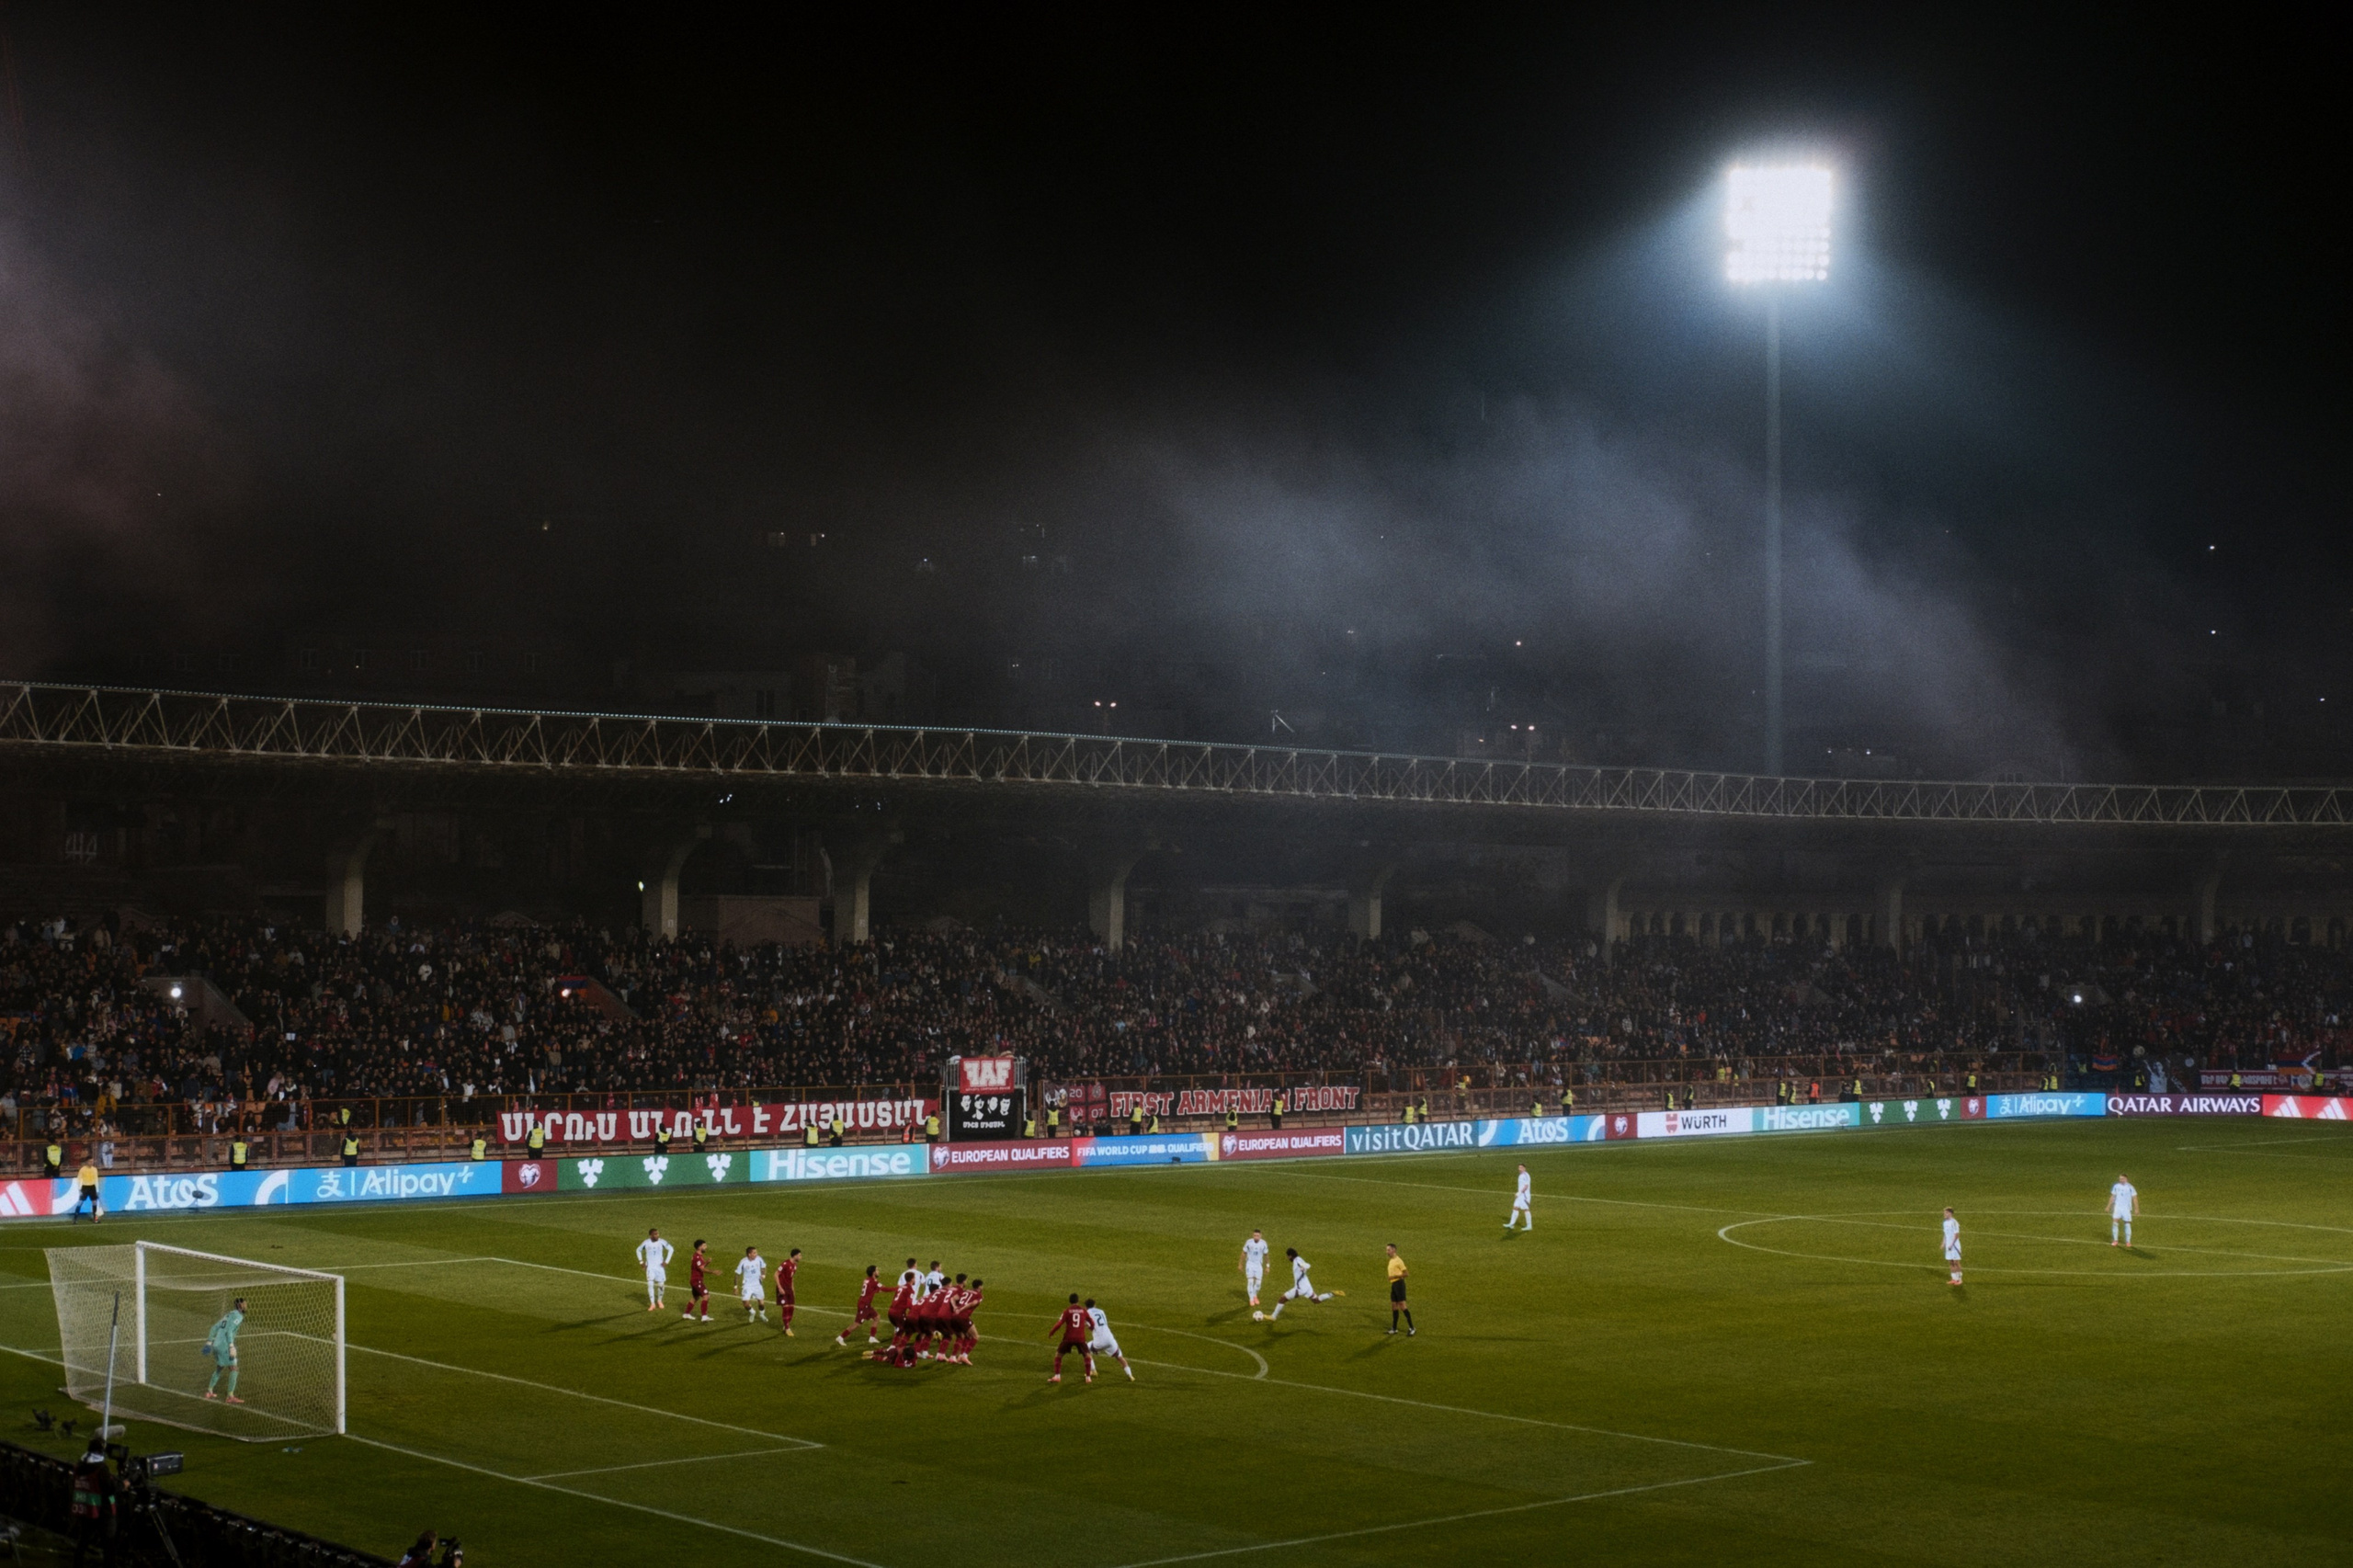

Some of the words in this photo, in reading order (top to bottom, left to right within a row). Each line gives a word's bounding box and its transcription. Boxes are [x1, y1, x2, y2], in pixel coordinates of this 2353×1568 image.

[1069, 1088, 1083, 1098] 20
[1109, 1092, 1174, 1118] FIRST
[1293, 1086, 1360, 1111] FRONT
[2108, 1096, 2173, 1116] QATAR
[2178, 1097, 2261, 1113] AIRWAYS
[1091, 1108, 1104, 1119] 07
[1762, 1107, 1850, 1131] Hisense
[1517, 1117, 1569, 1144] Atos
[1681, 1114, 1727, 1131] WÜRTH
[1076, 1146, 1097, 1157] FIFA
[1097, 1145, 1130, 1156] WORLD
[1130, 1144, 1148, 1154] CUP
[1167, 1142, 1214, 1153] QUALIFIERS
[1238, 1138, 1288, 1152] EUROPEAN
[1290, 1134, 1342, 1149] QUALIFIERS
[951, 1149, 1008, 1164] EUROPEAN
[1011, 1146, 1070, 1161] QUALIFIERS
[768, 1149, 911, 1180] Hisense
[125, 1173, 219, 1210] Atos
[894, 1288, 904, 1301] 3
[928, 1291, 941, 1303] 5
[943, 1290, 953, 1303] 2
[959, 1292, 973, 1305] 21
[1072, 1312, 1081, 1328] 9
